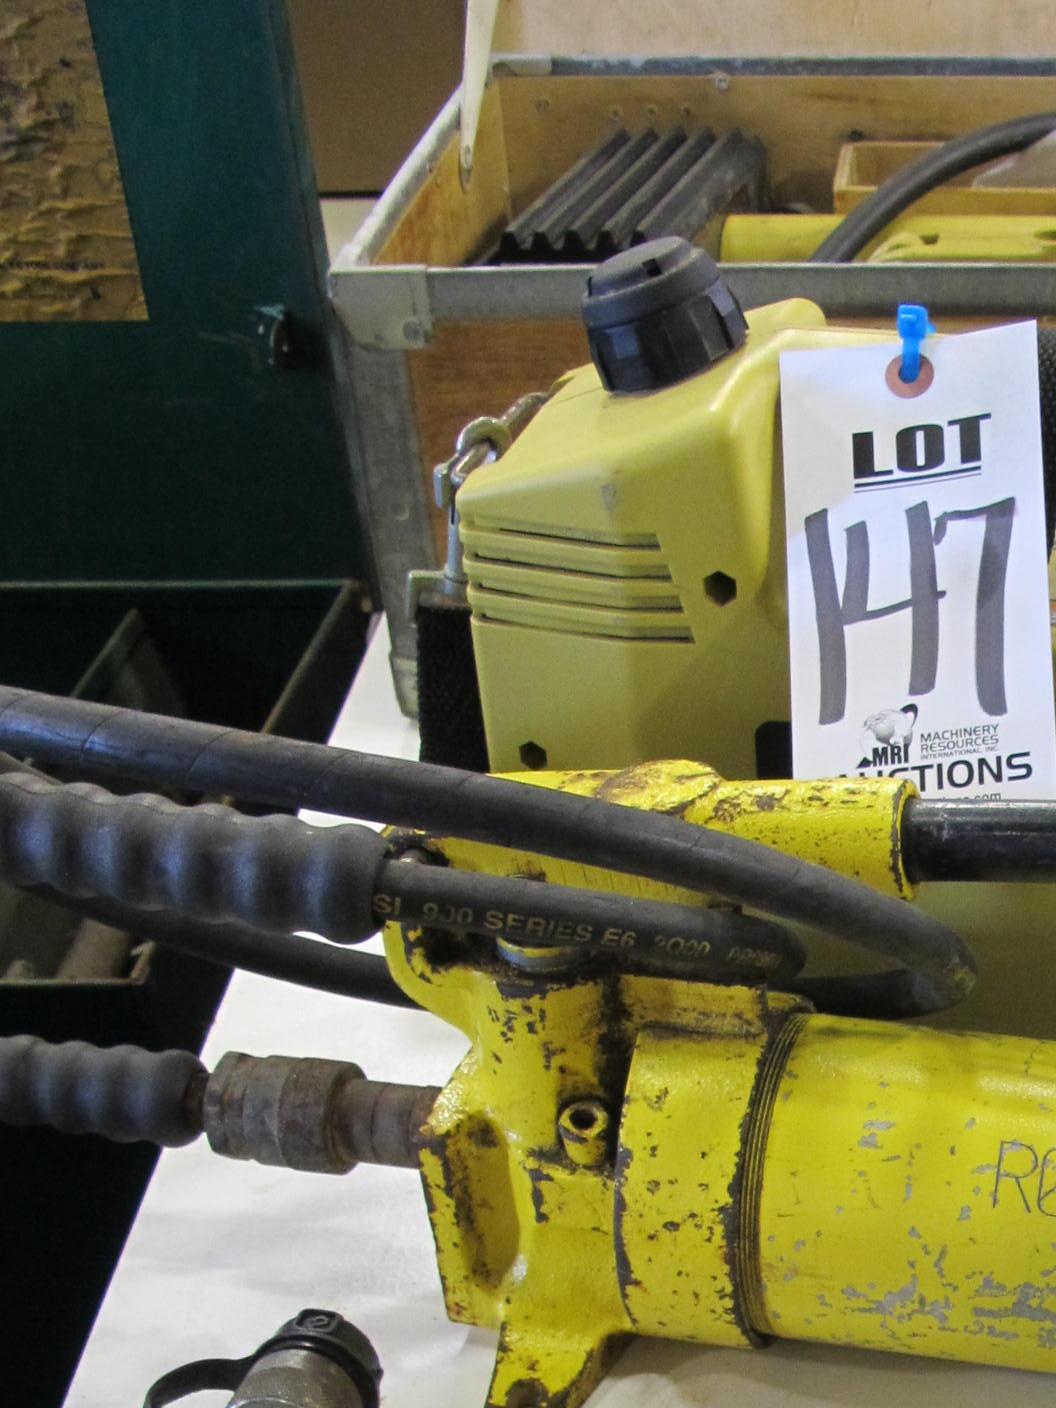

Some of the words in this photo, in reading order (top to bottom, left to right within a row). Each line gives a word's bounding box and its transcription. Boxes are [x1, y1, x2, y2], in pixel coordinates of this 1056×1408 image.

[852, 413, 991, 479] LOT
[805, 497, 1015, 725] 147
[920, 723, 999, 744] MACHINERY
[920, 735, 999, 754] RESOURCES
[872, 744, 909, 767] MRI
[485, 910, 592, 942] SERIES
